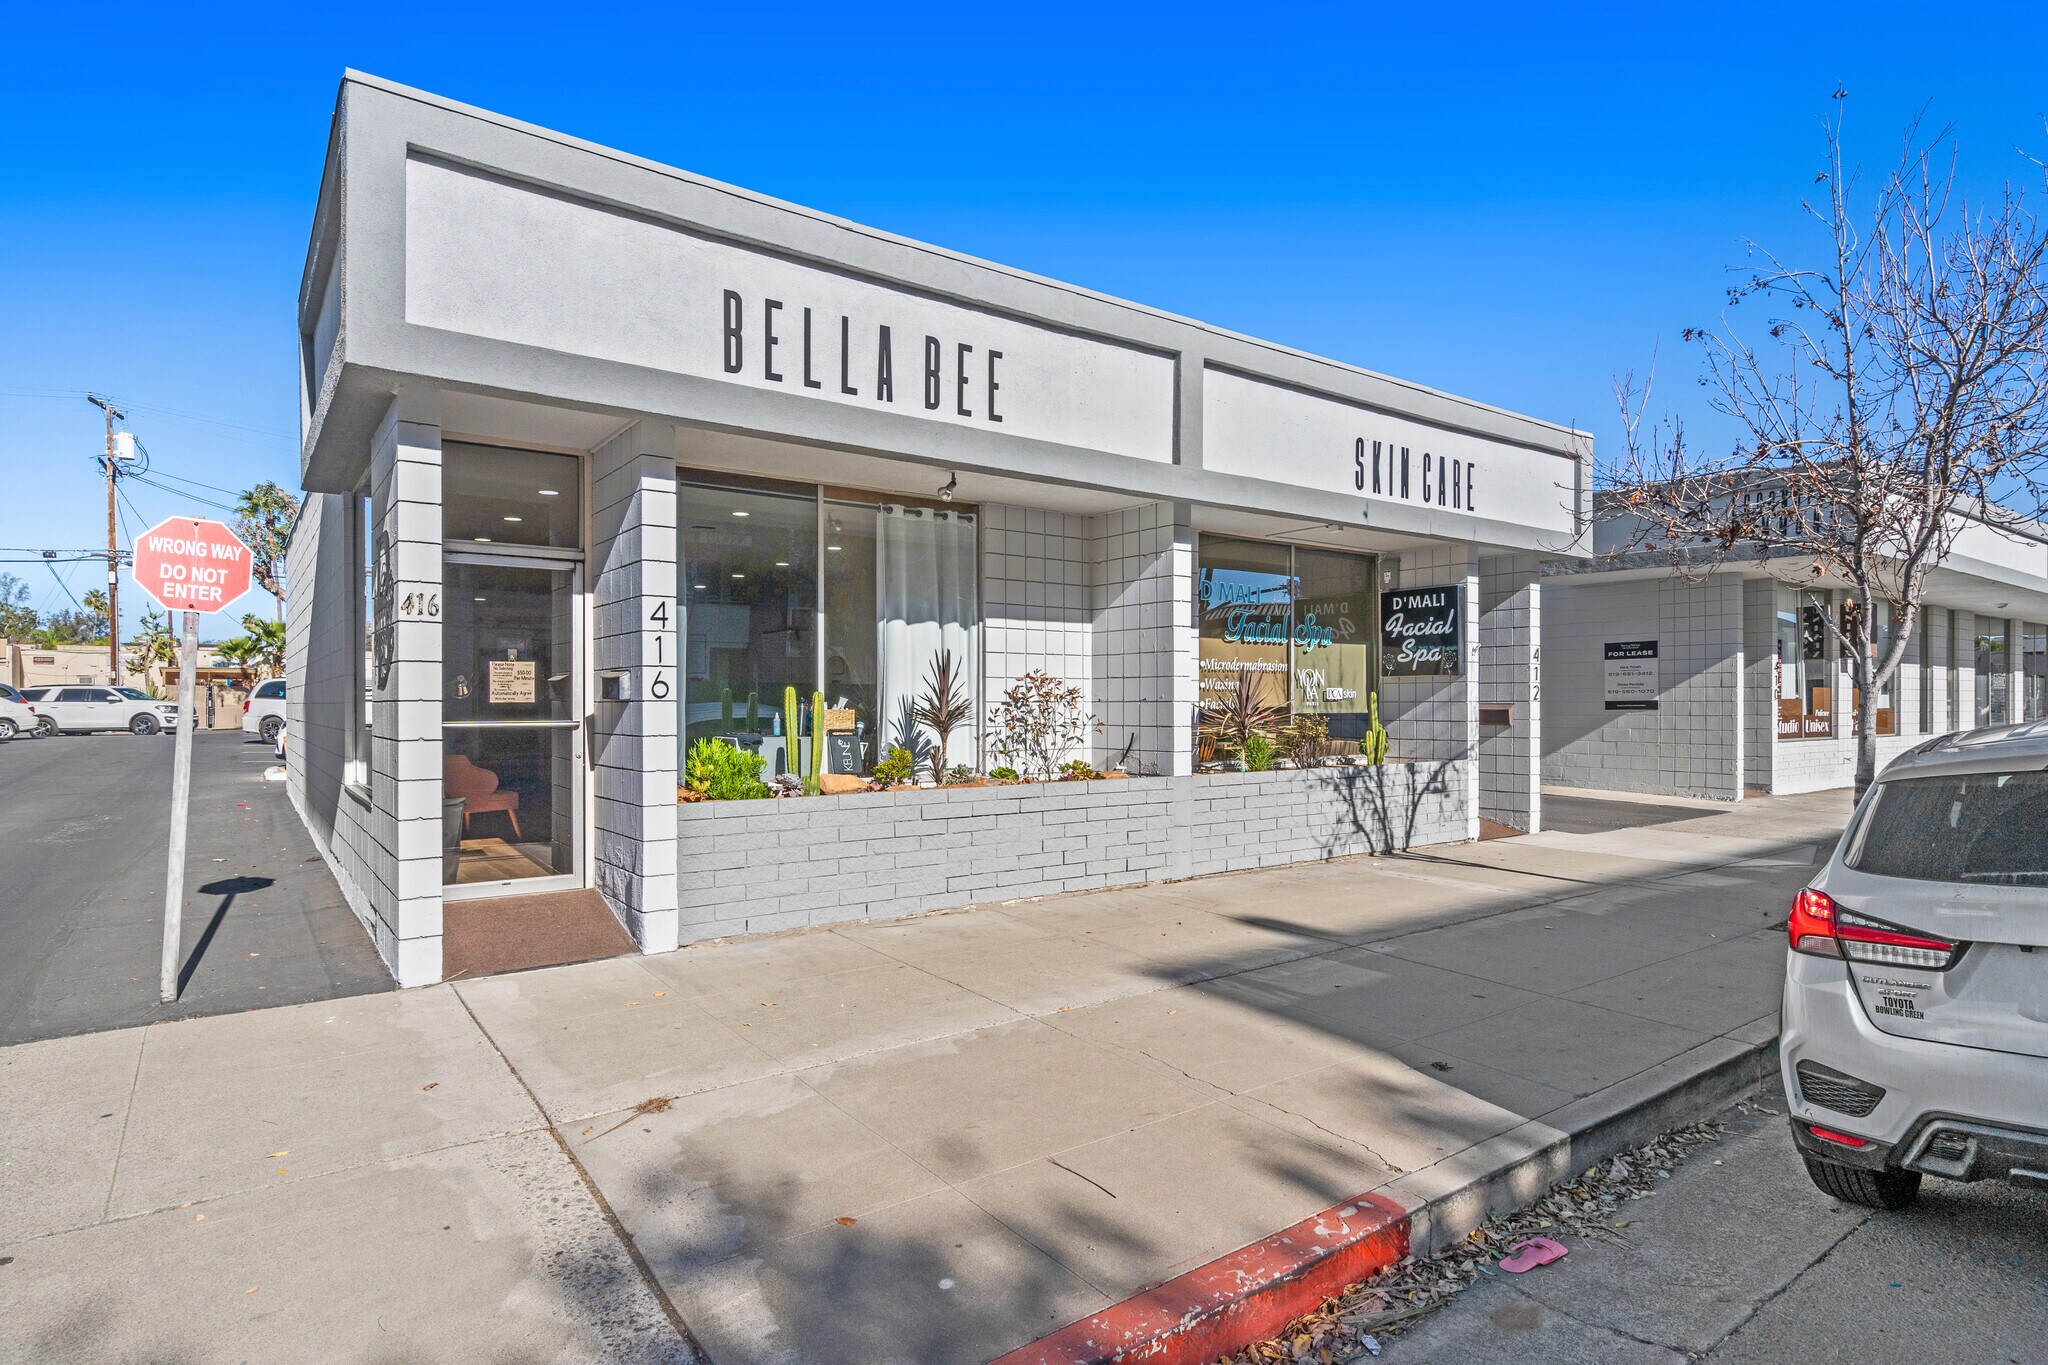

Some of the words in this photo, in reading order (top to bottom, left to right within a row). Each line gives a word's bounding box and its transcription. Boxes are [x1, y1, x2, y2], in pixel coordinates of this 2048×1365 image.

[723, 288, 893, 403] BELLA
[924, 334, 1003, 423] BEE
[1355, 437, 1410, 500] SKIN
[1422, 452, 1475, 511] CARE
[148, 536, 207, 557] WRONG
[211, 543, 243, 561] WAY
[160, 563, 187, 580] DO
[192, 567, 228, 584] NOT
[163, 582, 223, 602] ENTER
[1201, 580, 1261, 605] D'MALI
[1392, 593, 1445, 610] D'MALI
[401, 592, 439, 617] 416
[1224, 608, 1290, 644] Facial
[1293, 612, 1332, 653] Spa
[1385, 608, 1454, 638] Facial
[650, 601, 669, 699] 416
[1397, 638, 1441, 671] Spa
[1205, 657, 1288, 672] Microdermabrasion
[1532, 648, 1540, 701] 412
[1343, 688, 1357, 699] skin
[1777, 719, 1800, 734] tudio
[1805, 719, 1830, 733] Unisex
[1861, 976, 1931, 990] OUTLANDER
[1877, 988, 1918, 998] SPORT
[1875, 1005, 1904, 1017] BOWLING
[1904, 1009, 1924, 1019] GREEN
[1883, 996, 1914, 1010] TOYOTA
